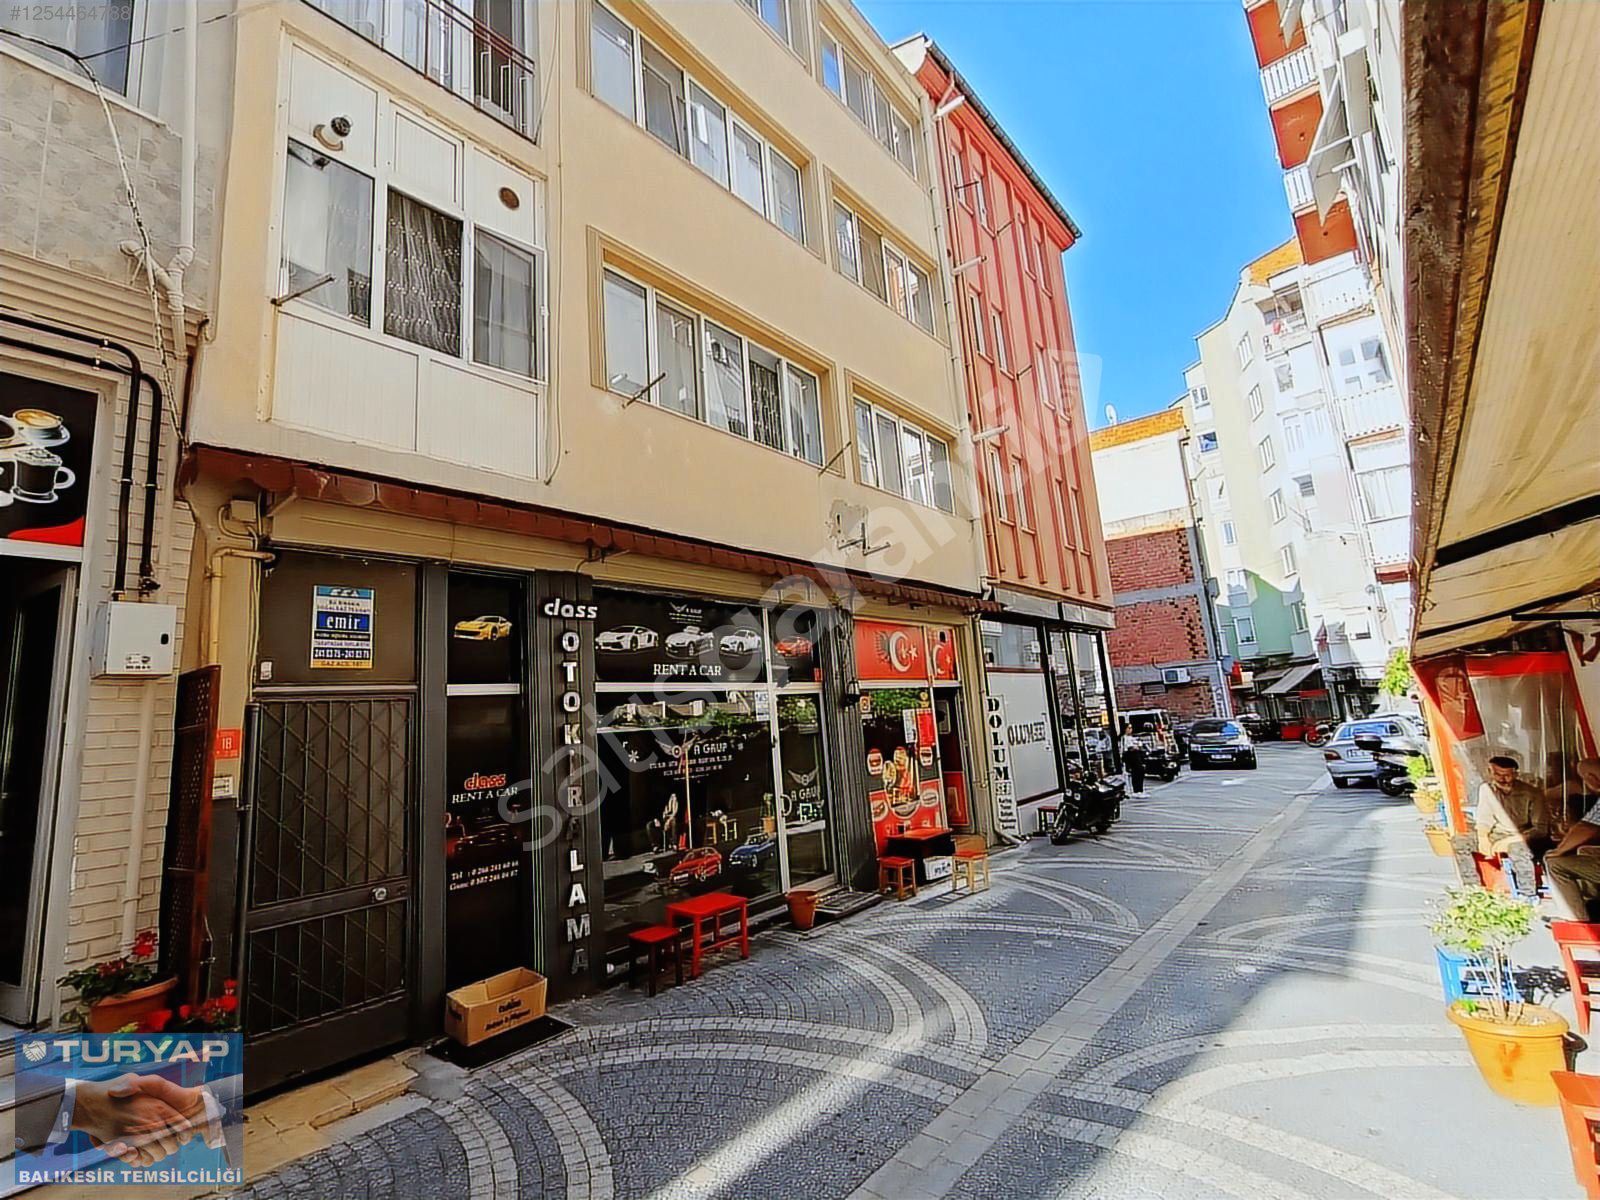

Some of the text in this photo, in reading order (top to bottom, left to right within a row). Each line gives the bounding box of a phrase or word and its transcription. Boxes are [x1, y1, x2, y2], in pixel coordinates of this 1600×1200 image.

[544, 598, 598, 619] class
[326, 614, 361, 630] emir
[653, 663, 723, 676] RENT A CAR
[464, 772, 507, 790] class
[451, 786, 518, 804] RENT A CAR
